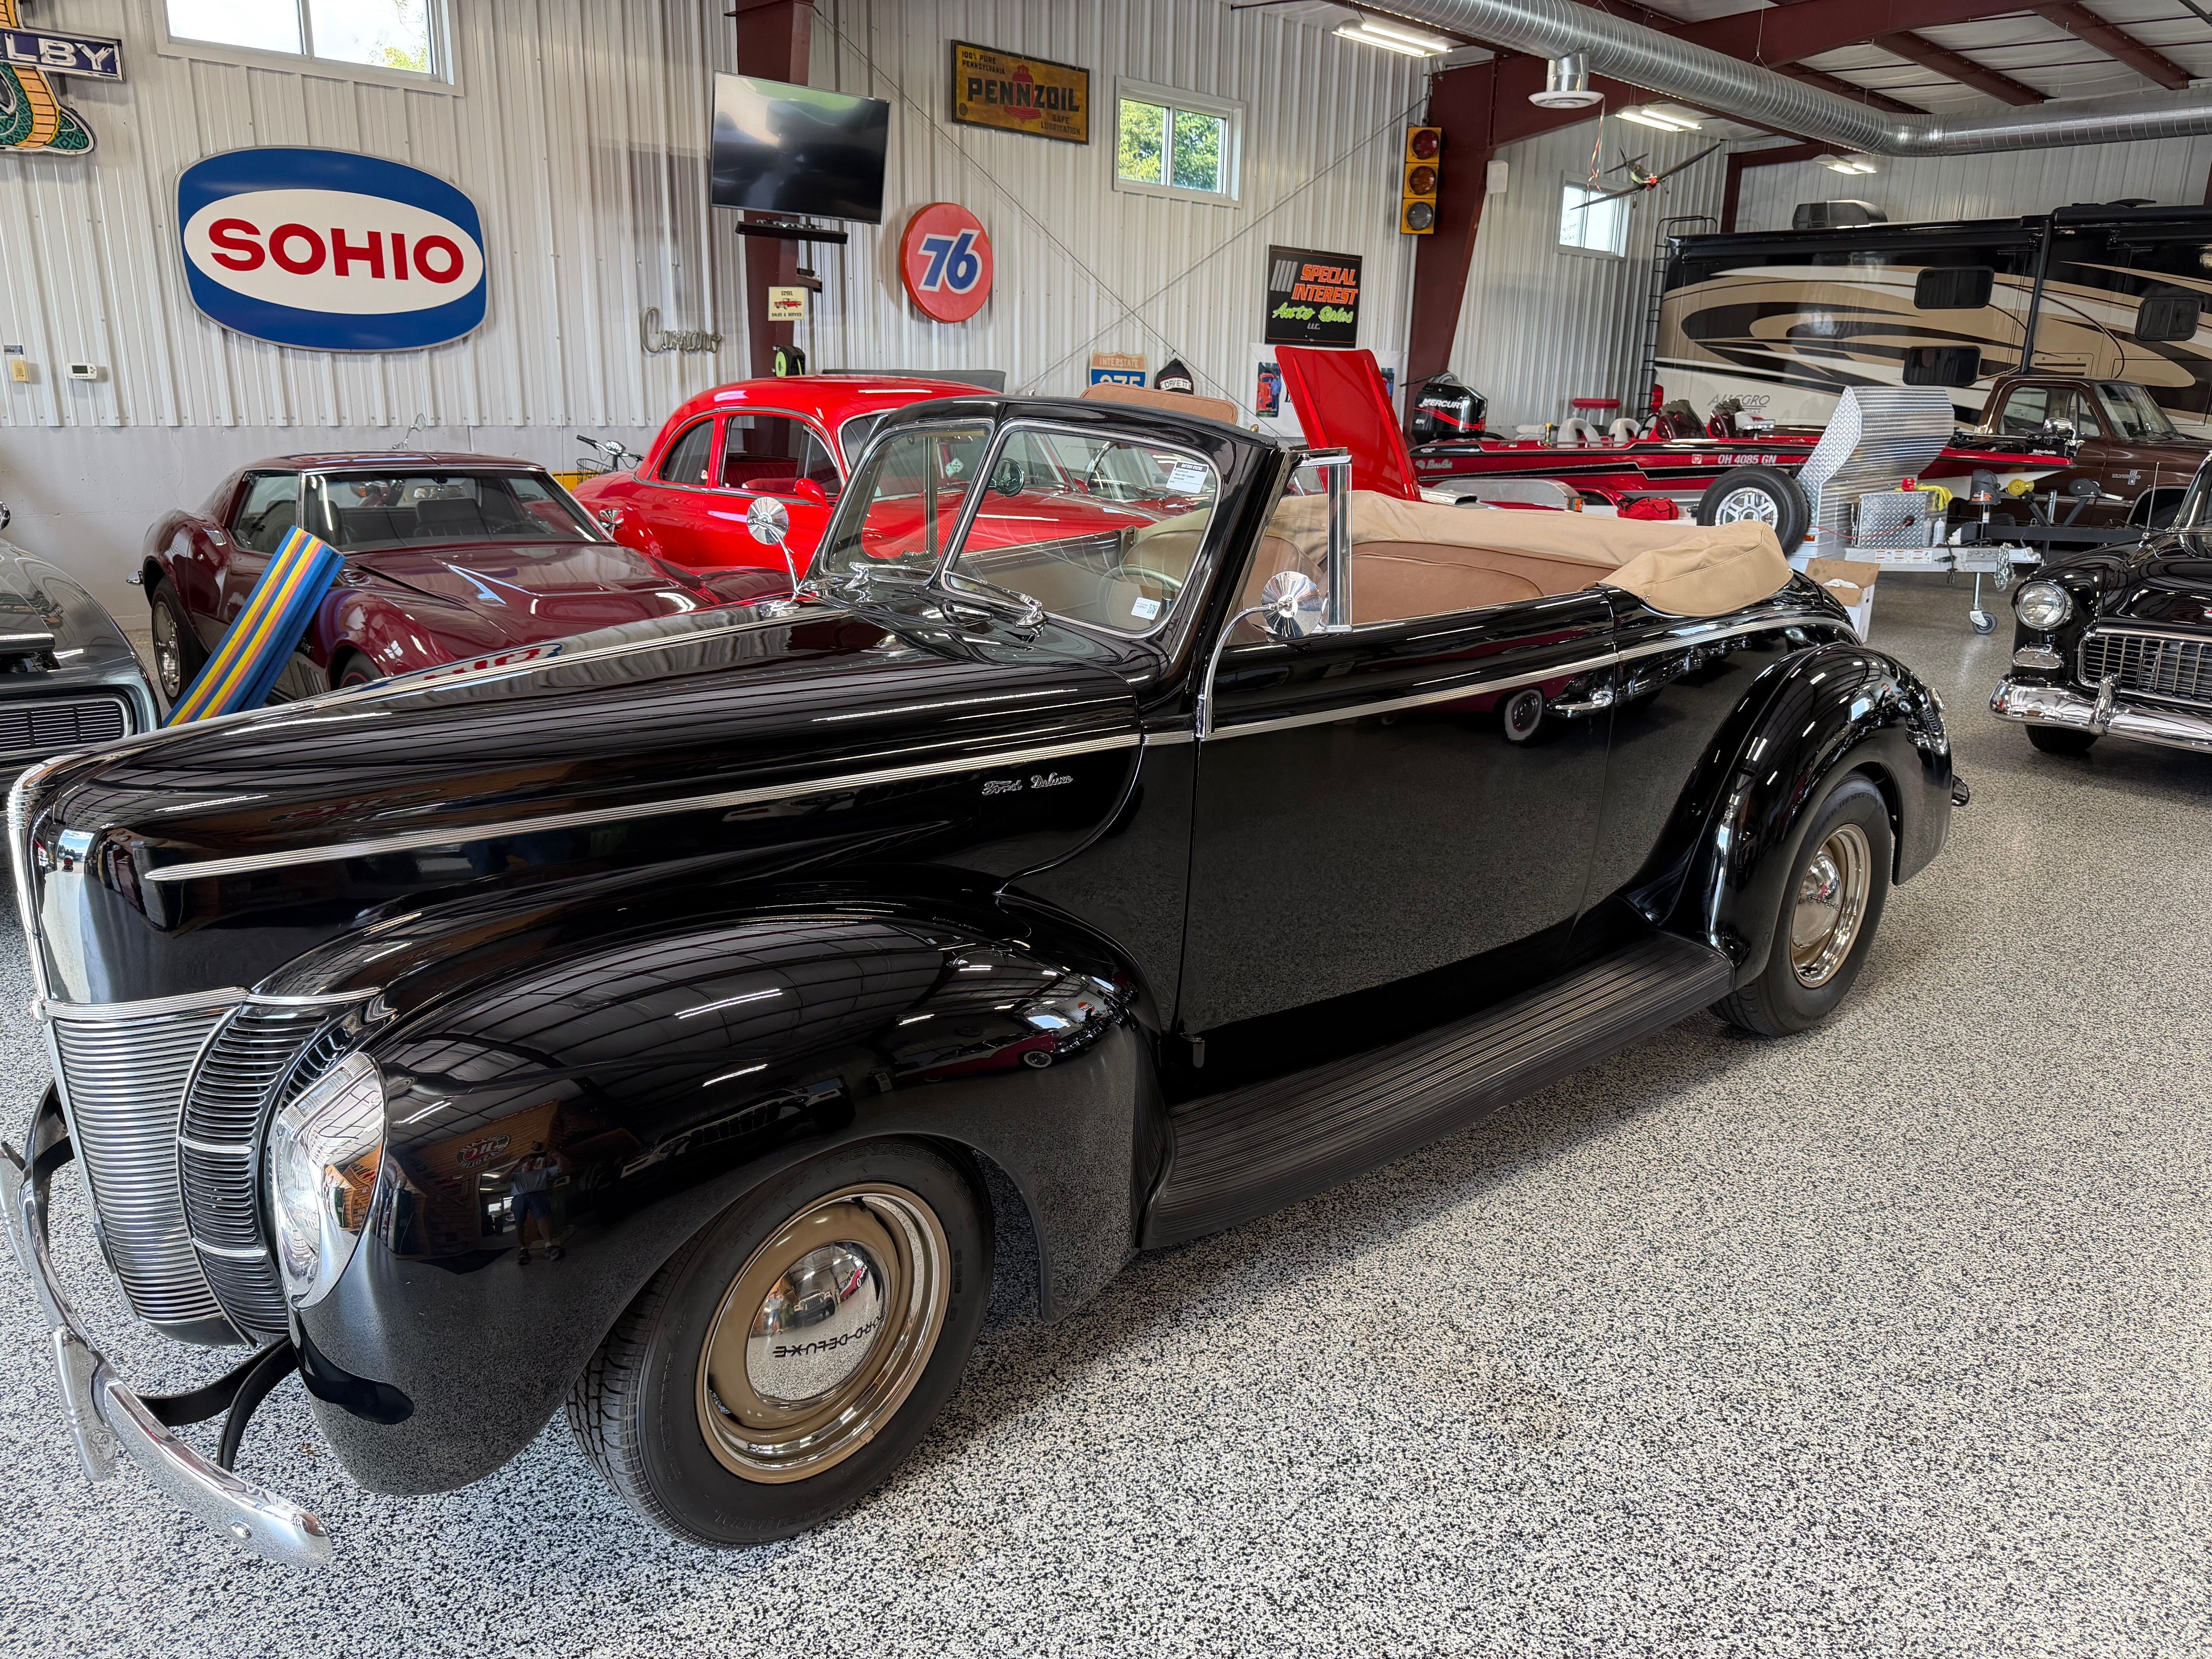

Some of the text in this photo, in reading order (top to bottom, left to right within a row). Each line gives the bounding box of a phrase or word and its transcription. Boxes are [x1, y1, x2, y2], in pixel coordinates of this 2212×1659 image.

[0, 33, 114, 70] LBY
[962, 51, 996, 64] 100% PURE
[962, 60, 1005, 75] PENNSYLVANIA
[968, 77, 1080, 112] PENNZOIL
[1041, 122, 1080, 135] LUBRICATION
[1053, 114, 1070, 124] SAFE
[208, 218, 464, 284] SOHIO
[917, 228, 981, 294] 76
[1300, 264, 1357, 285] SPECIAL
[1291, 283, 1358, 305] INTEREST
[1272, 301, 1354, 324] Auto Sales
[641, 306, 722, 353] Camaro
[1099, 357, 1139, 368] INTERSTATE
[1419, 398, 1465, 409] MERCURY
[1717, 454, 1777, 465] OH 4085 GN
[982, 780, 1022, 795] Ford
[819, 1141, 955, 1179] TRENDSETTER
